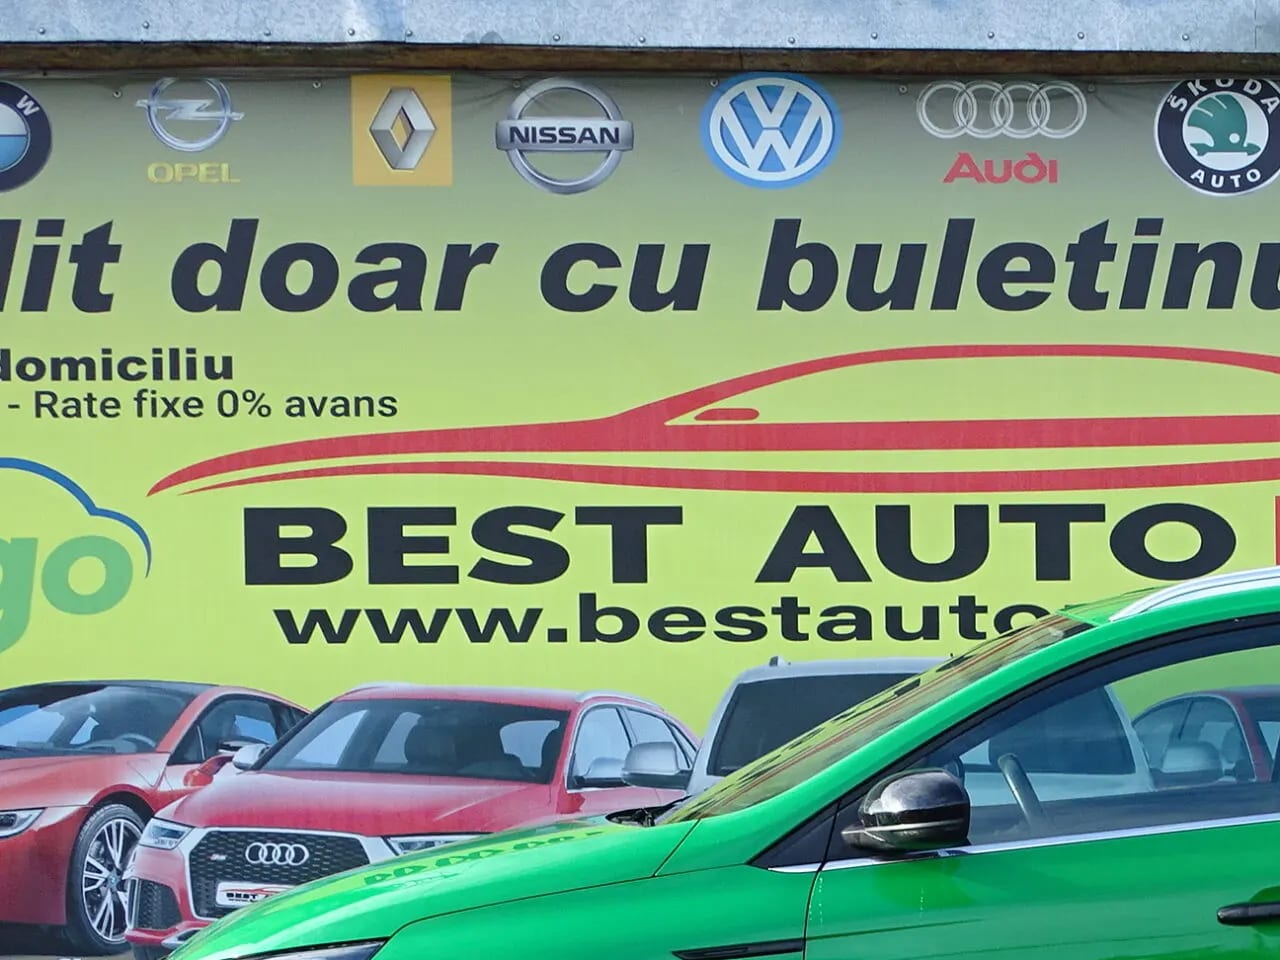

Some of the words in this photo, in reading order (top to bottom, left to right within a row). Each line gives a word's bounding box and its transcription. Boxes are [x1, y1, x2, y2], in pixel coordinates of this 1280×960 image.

[508, 126, 620, 145] NISSAN
[147, 162, 241, 184] OPEL
[943, 152, 1058, 184] Audi
[1190, 168, 1261, 188] AUTO
[0, 219, 121, 313] it
[171, 219, 499, 313] doar
[540, 243, 710, 313] cu
[34, 390, 122, 418] Rate
[133, 388, 204, 418] fixe
[216, 389, 272, 418] 0%
[285, 395, 398, 418] avans
[243, 505, 683, 585] BEST
[755, 503, 1237, 582] AUTO
